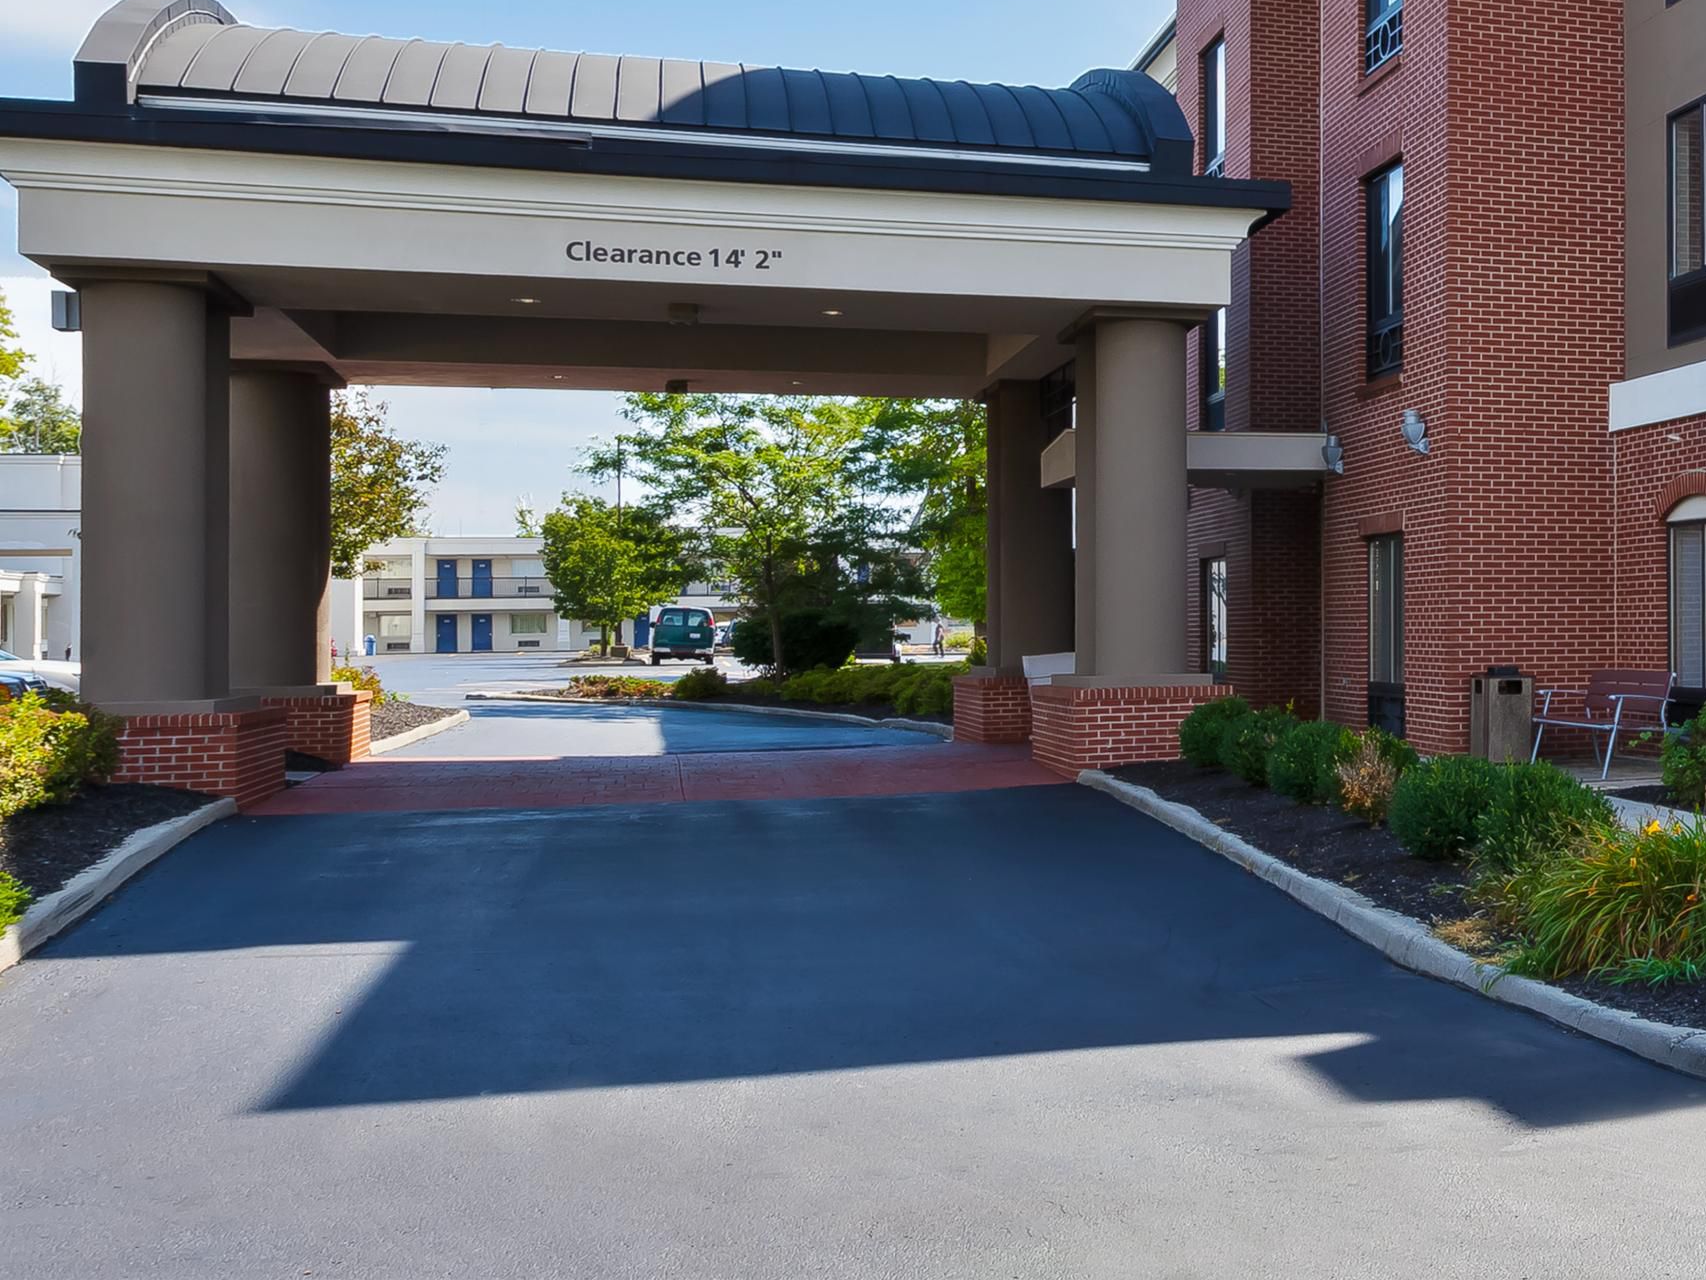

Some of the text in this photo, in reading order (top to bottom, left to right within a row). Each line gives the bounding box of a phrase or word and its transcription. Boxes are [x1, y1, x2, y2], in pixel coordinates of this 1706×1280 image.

[565, 240, 783, 270] Clearance 14' 2"
